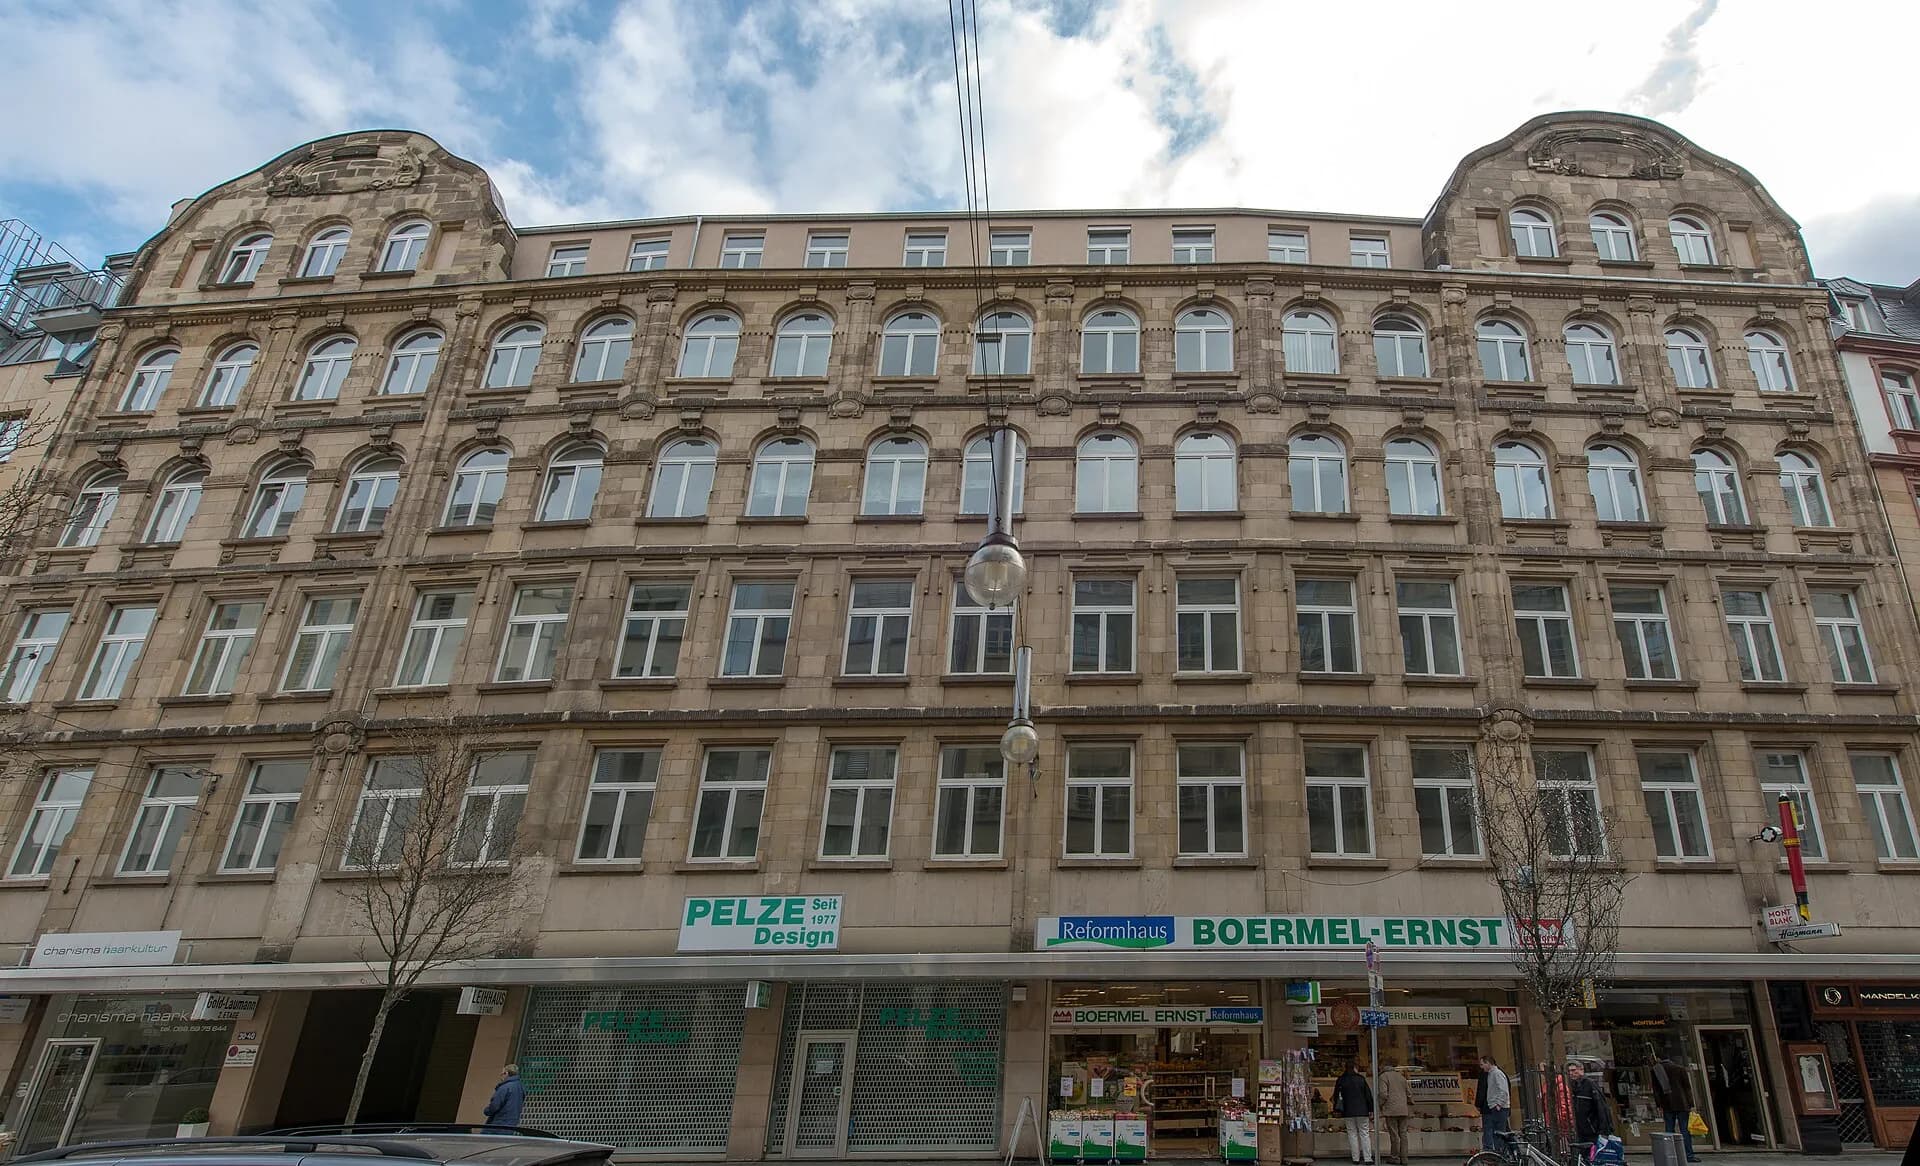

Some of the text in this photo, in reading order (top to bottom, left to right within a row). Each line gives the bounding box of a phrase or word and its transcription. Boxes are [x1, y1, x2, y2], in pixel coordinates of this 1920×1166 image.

[812, 898, 838, 910] Seit
[686, 898, 806, 926] PELZE
[1768, 908, 1791, 918] MONT
[811, 915, 836, 925] 1977
[1770, 916, 1793, 926] BLANC
[1063, 921, 1167, 940] Reformhaus
[1193, 919, 1502, 946] BOERMEL-ERNST
[754, 927, 834, 948] Design
[43, 944, 167, 956] charisma haarkultur
[207, 996, 256, 1011] Gold-Laumann
[57, 1010, 189, 1023] charisma haark
[1075, 1010, 1206, 1023] BOERMEL ERNST
[1212, 1010, 1258, 1020] Reformhaus
[1388, 1012, 1451, 1020] ERMEL-ERNST
[1411, 1078, 1460, 1089] BIRKENSTOCK
